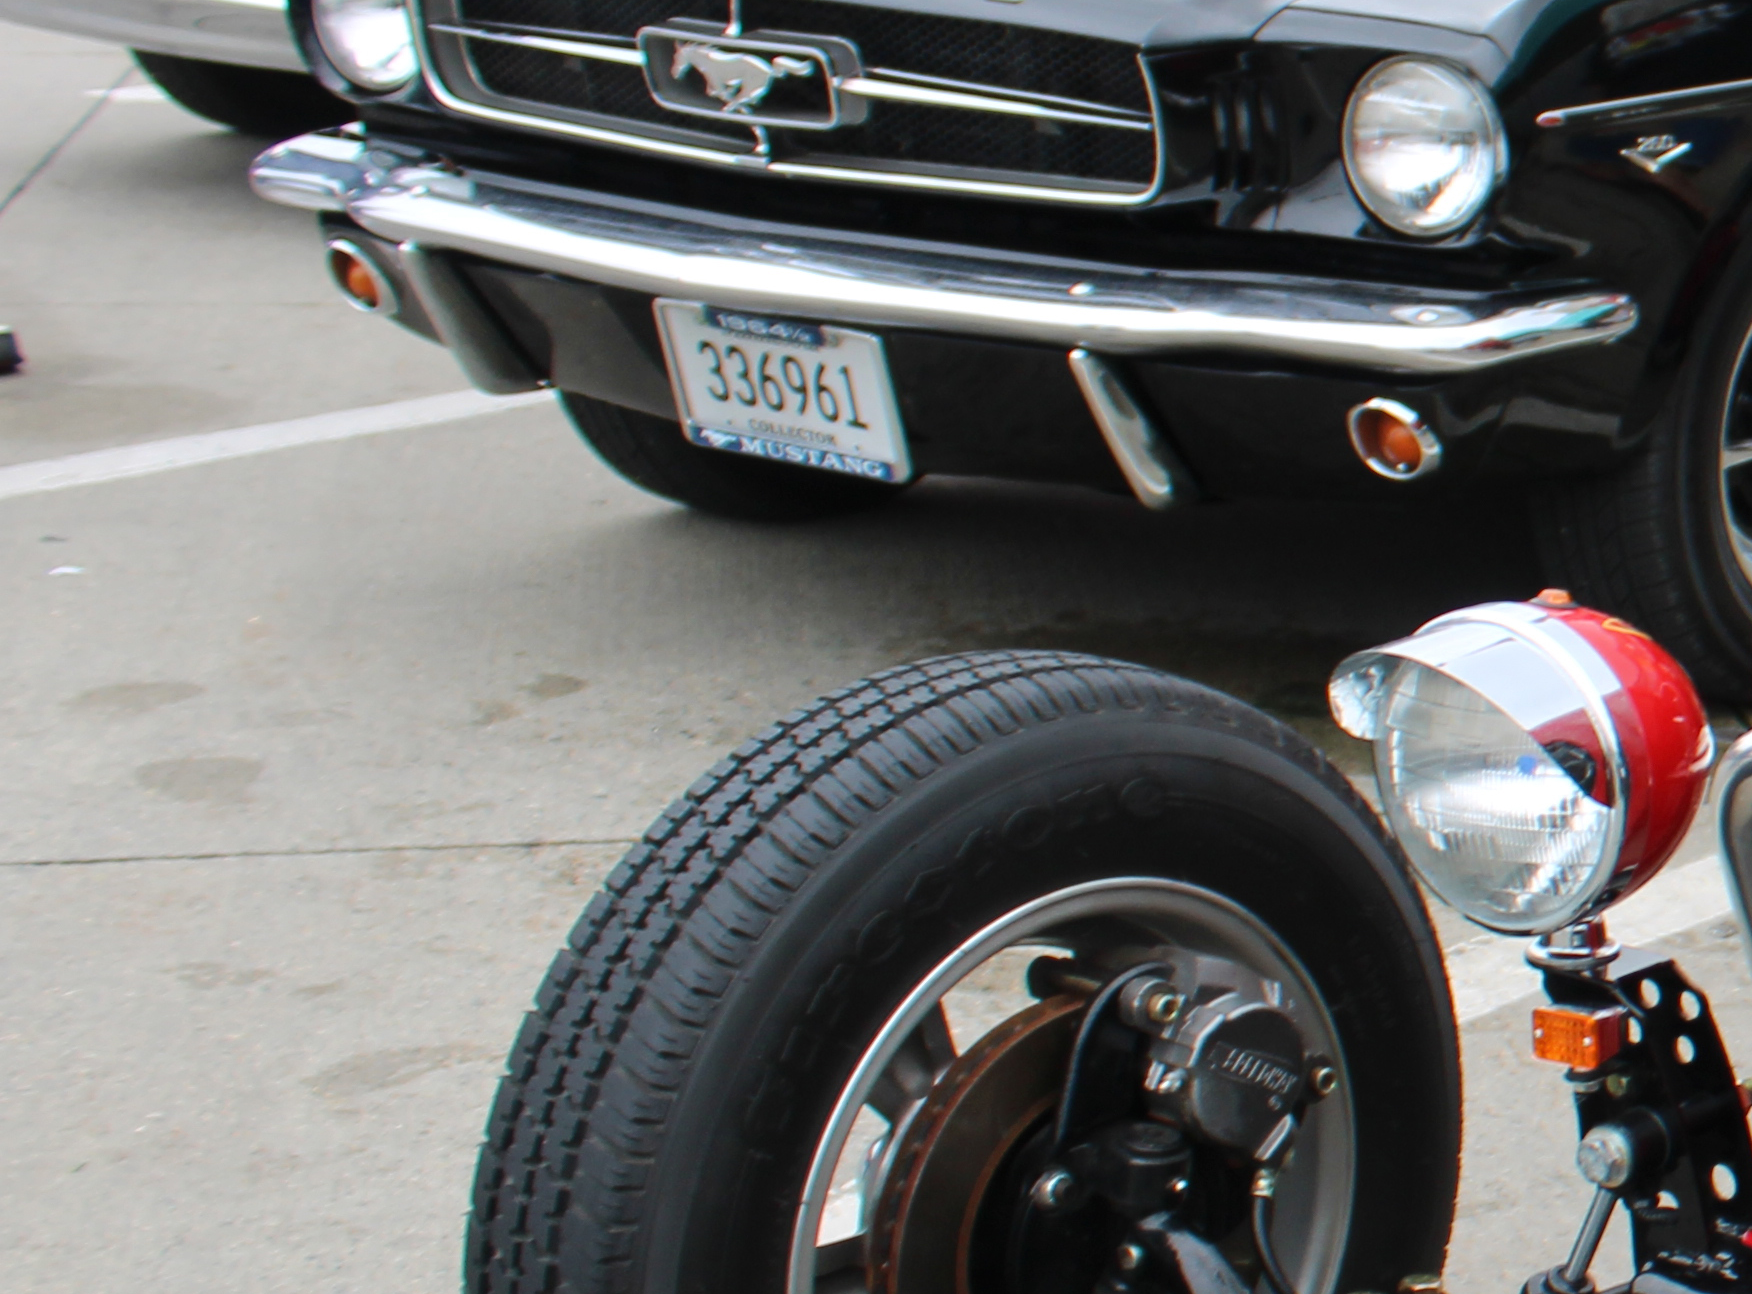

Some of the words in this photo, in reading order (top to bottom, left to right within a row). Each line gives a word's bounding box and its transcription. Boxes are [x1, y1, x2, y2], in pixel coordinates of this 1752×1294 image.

[697, 339, 868, 429] 336961
[748, 418, 836, 445] COLLECTOR
[739, 437, 884, 478] MUSTANG
